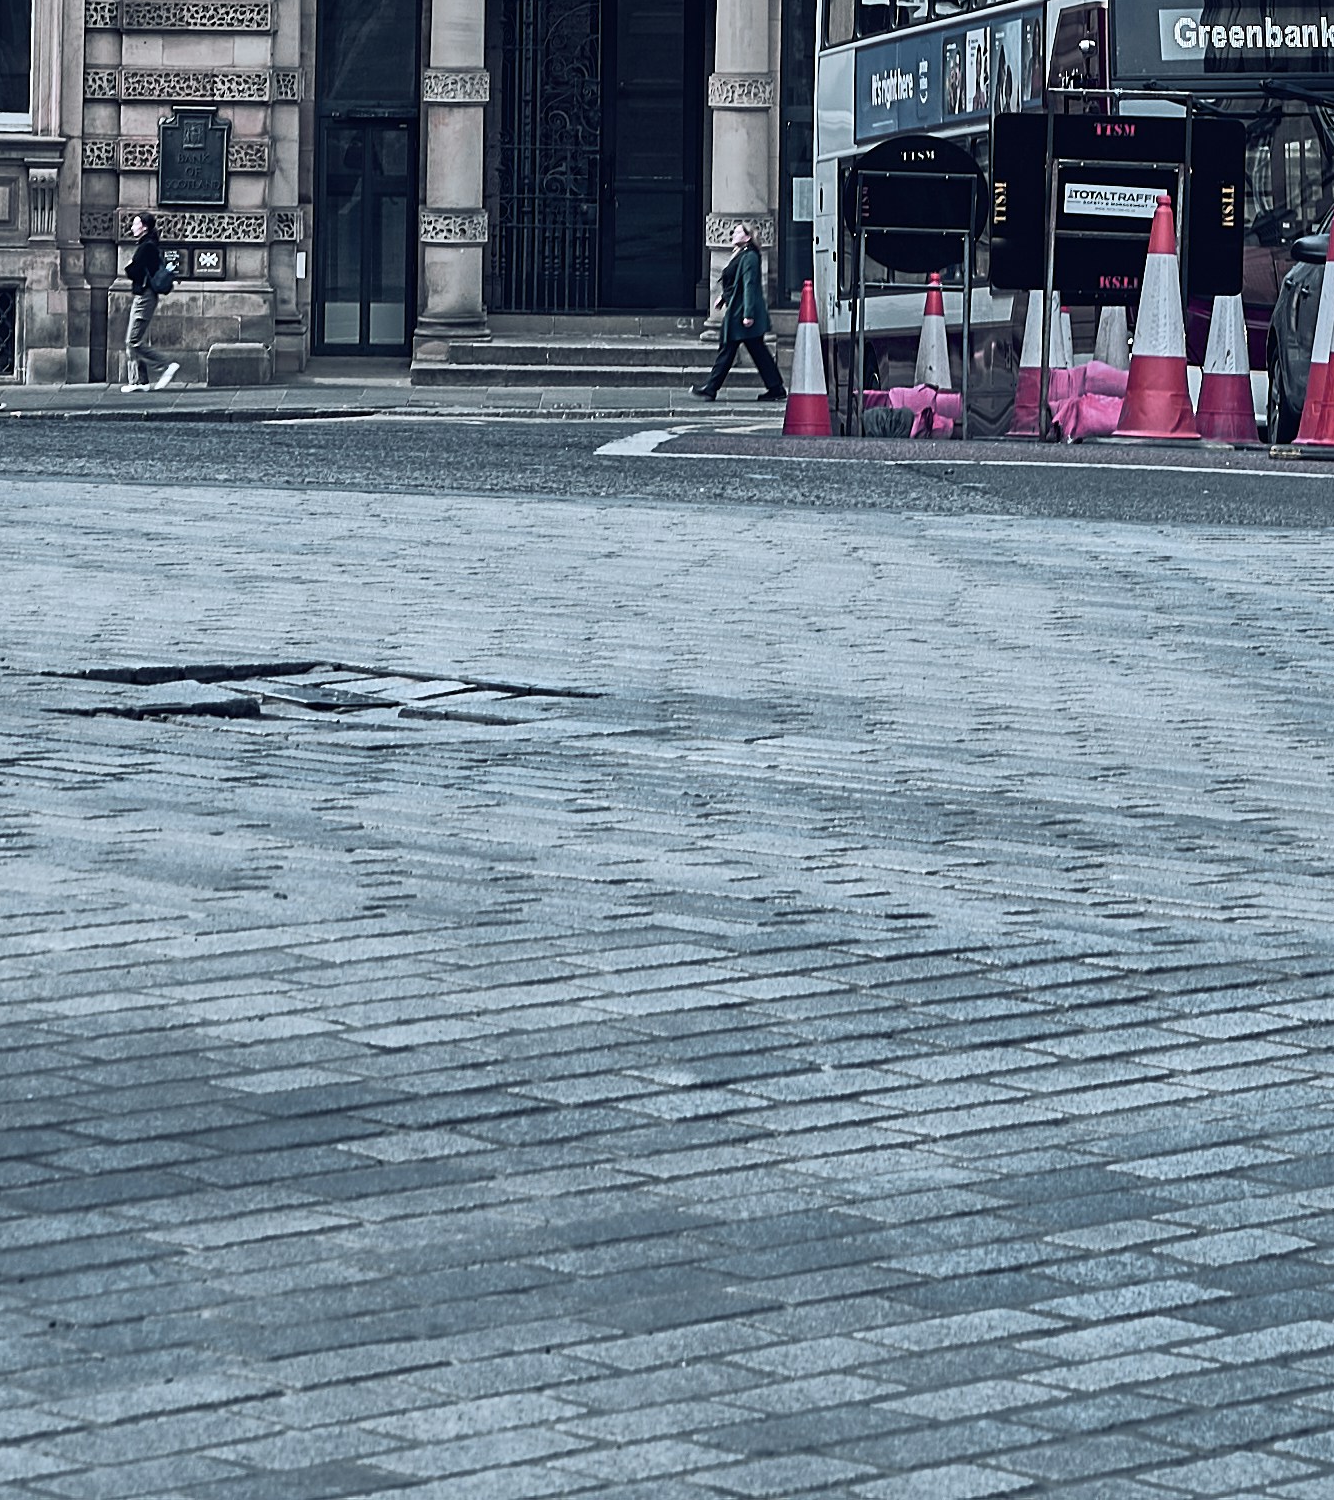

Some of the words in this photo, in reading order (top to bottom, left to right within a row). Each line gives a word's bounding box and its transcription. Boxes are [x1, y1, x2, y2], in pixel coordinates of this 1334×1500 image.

[897, 67, 914, 100] here
[1093, 122, 1136, 137] TTSM
[177, 153, 211, 165] BANK
[184, 166, 203, 177] OF
[164, 179, 222, 190] SCOTLAND
[1222, 184, 1235, 227] TTSM
